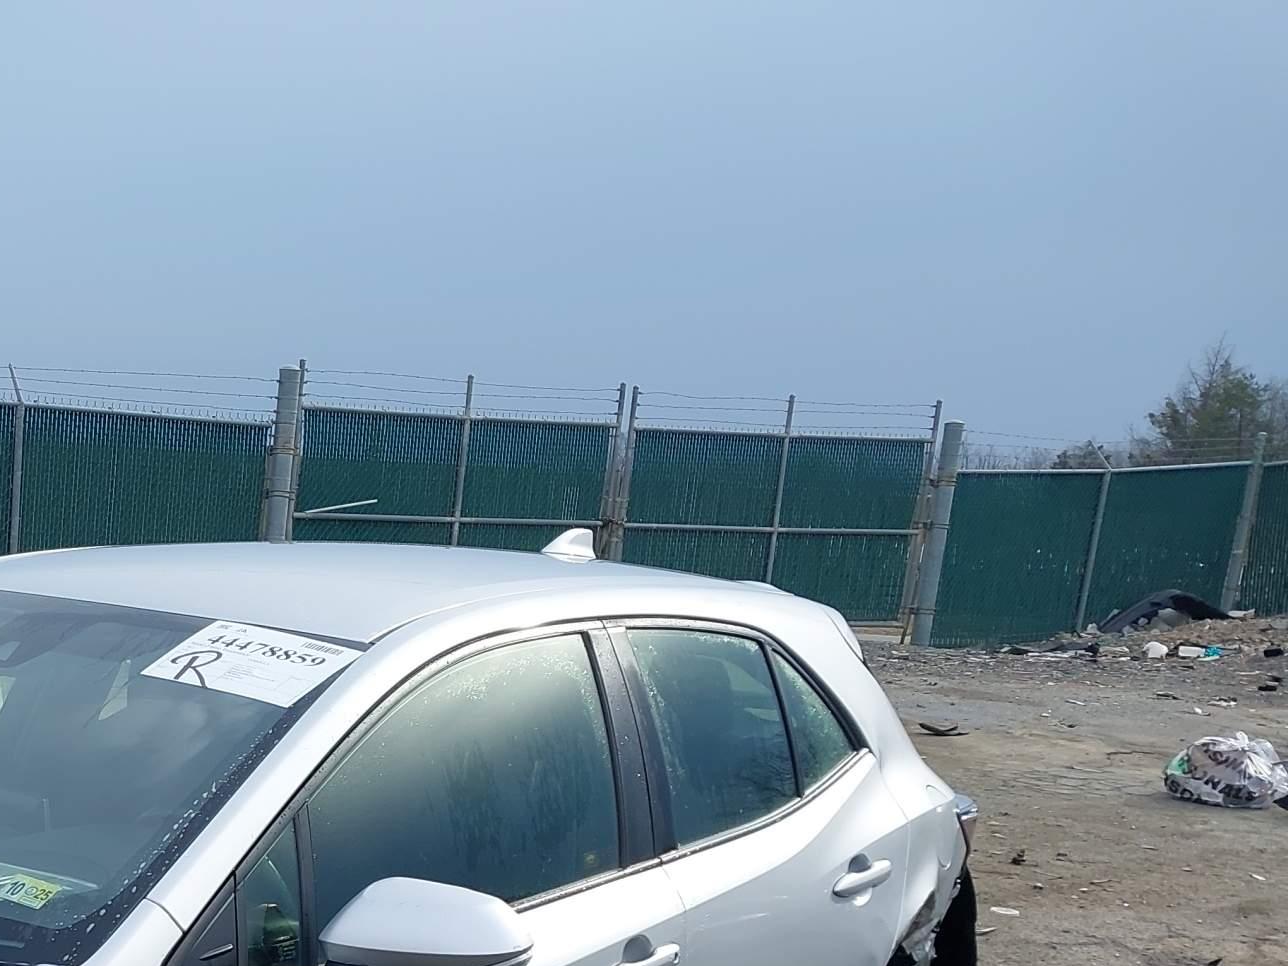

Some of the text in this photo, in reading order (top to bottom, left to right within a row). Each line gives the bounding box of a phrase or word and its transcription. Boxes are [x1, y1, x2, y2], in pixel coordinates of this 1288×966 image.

[208, 633, 327, 668] 44478859
[171, 650, 223, 689] R
[6, 881, 53, 901] 10 25
